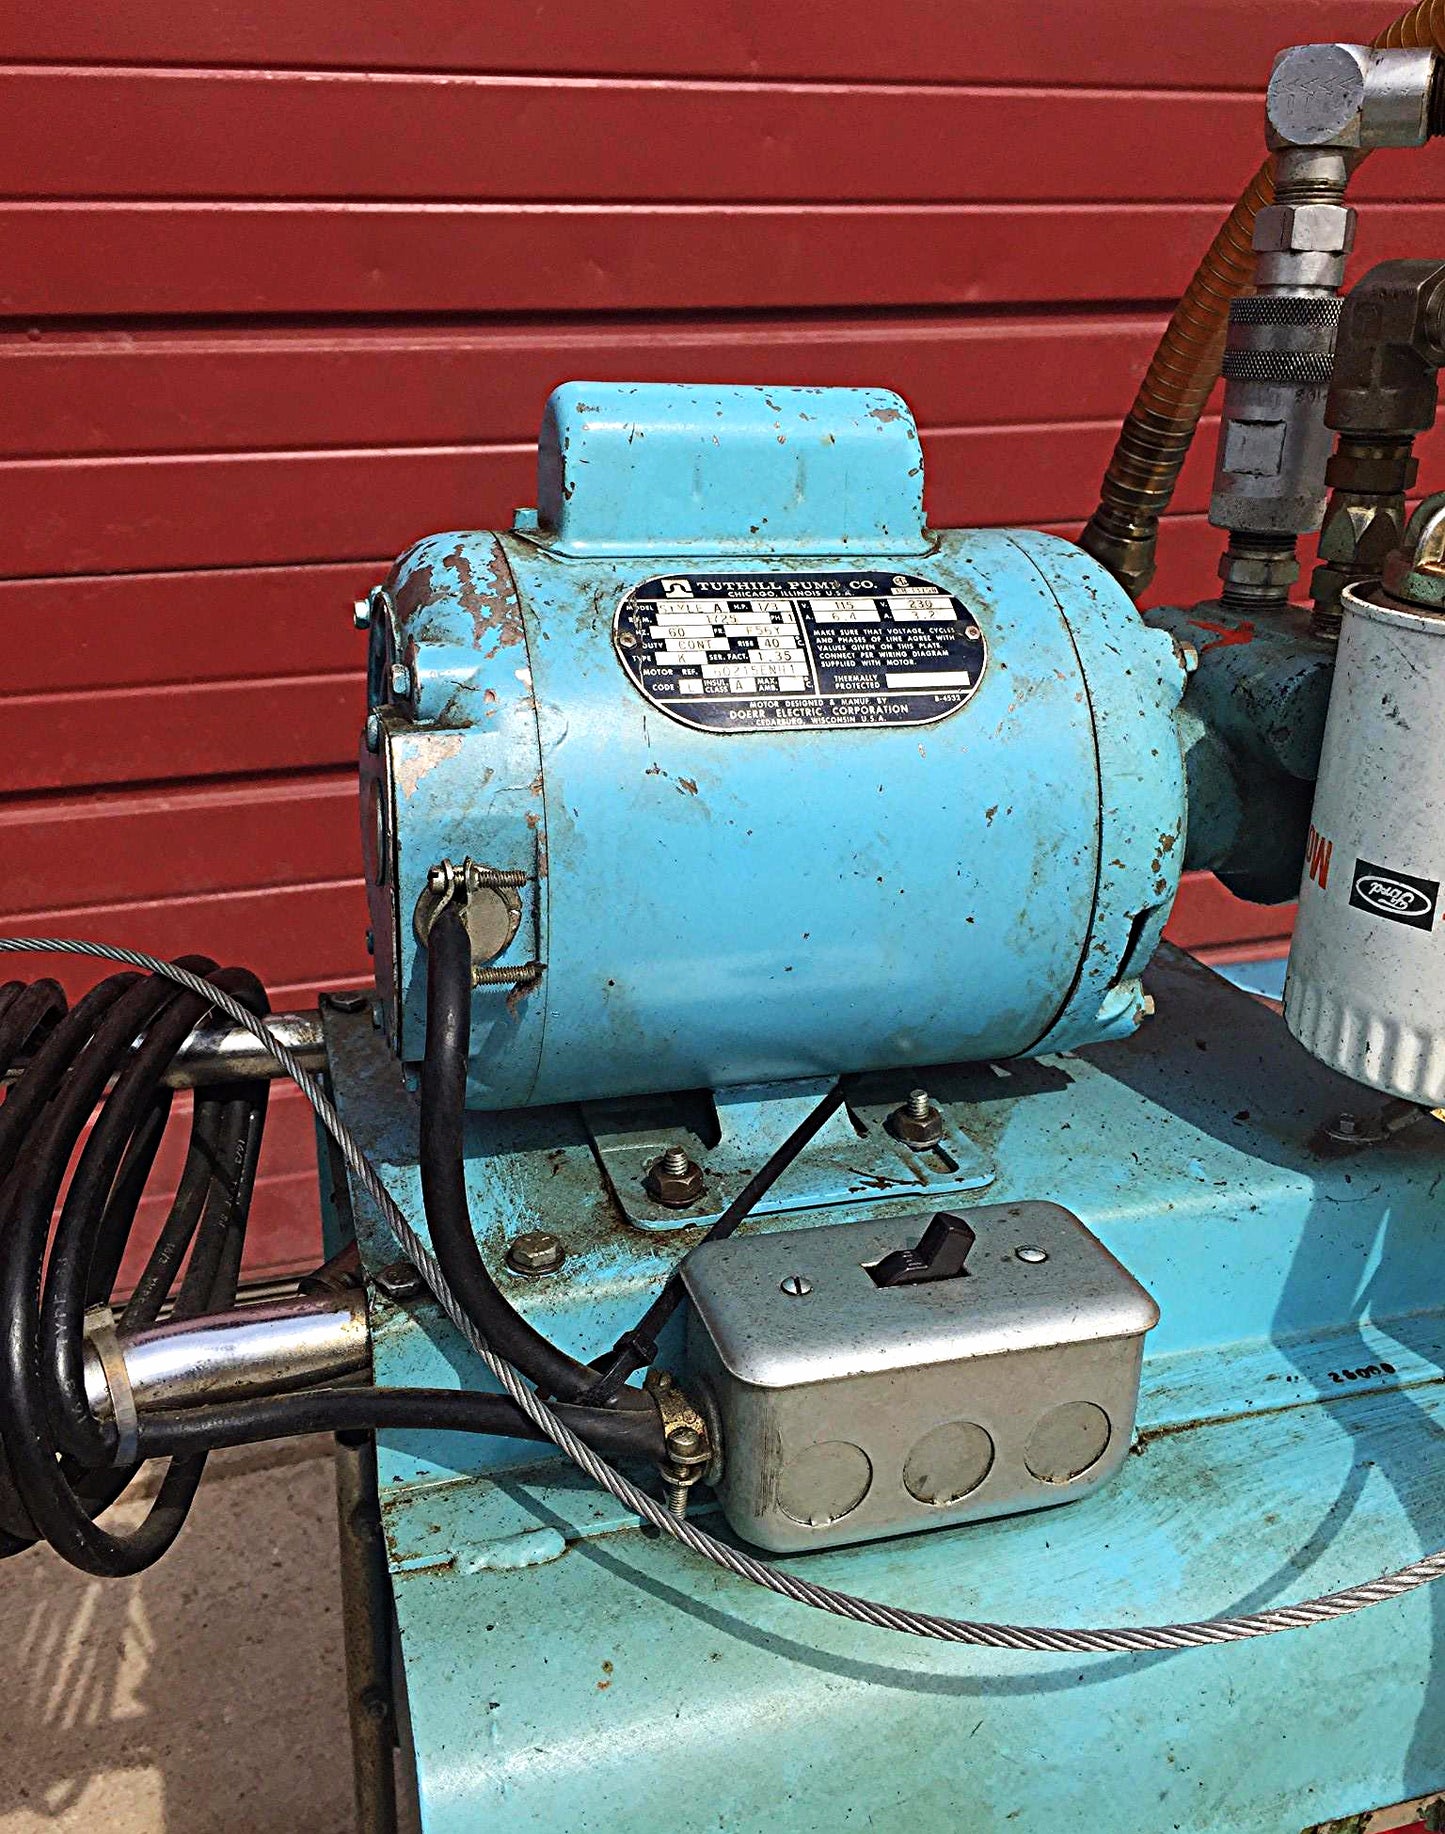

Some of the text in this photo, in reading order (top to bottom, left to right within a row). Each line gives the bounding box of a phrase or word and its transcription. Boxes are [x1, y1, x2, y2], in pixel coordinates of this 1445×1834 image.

[696, 579, 878, 591] TUTHILL PUMP CO.
[727, 589, 855, 598] CHICAGO, ILLINOIS U.S.A.
[659, 603, 704, 614] STYLE
[713, 602, 723, 614] A
[733, 602, 748, 610] H.P.
[758, 602, 779, 612] 1/3
[834, 600, 854, 610] 115
[908, 599, 933, 609] 230
[831, 611, 857, 622] 6.4
[911, 610, 935, 620] 3.2
[668, 626, 686, 638] 60
[678, 639, 712, 650] CONT
[764, 638, 780, 648] 40
[817, 644, 847, 652] VALUES
[880, 643, 893, 651] ON
[708, 653, 726, 661] SER.
[758, 650, 792, 662] 1.35
[819, 652, 856, 660] CONNECT
[911, 650, 950, 658] DIAGRAM
[820, 660, 857, 668] SUPPLIED
[886, 658, 917, 666] MOTOR.
[643, 668, 674, 676] MOTOR
[681, 668, 699, 676] REF.
[833, 674, 879, 682] THERMALLY
[652, 684, 675, 692] CODE
[735, 679, 744, 691] A
[757, 677, 778, 685] MAX.
[835, 681, 881, 690] PROTECTED
[704, 686, 729, 694] CLASS
[749, 700, 780, 709] MOTOR
[785, 699, 824, 708] DESIGNED
[876, 697, 888, 705] BY
[729, 704, 910, 720] DOERR ELECTRIC CORPORATION
[811, 715, 856, 725] WISCONSIN
[861, 714, 887, 723] U.S.A.
[1368, 881, 1415, 911] Ford
